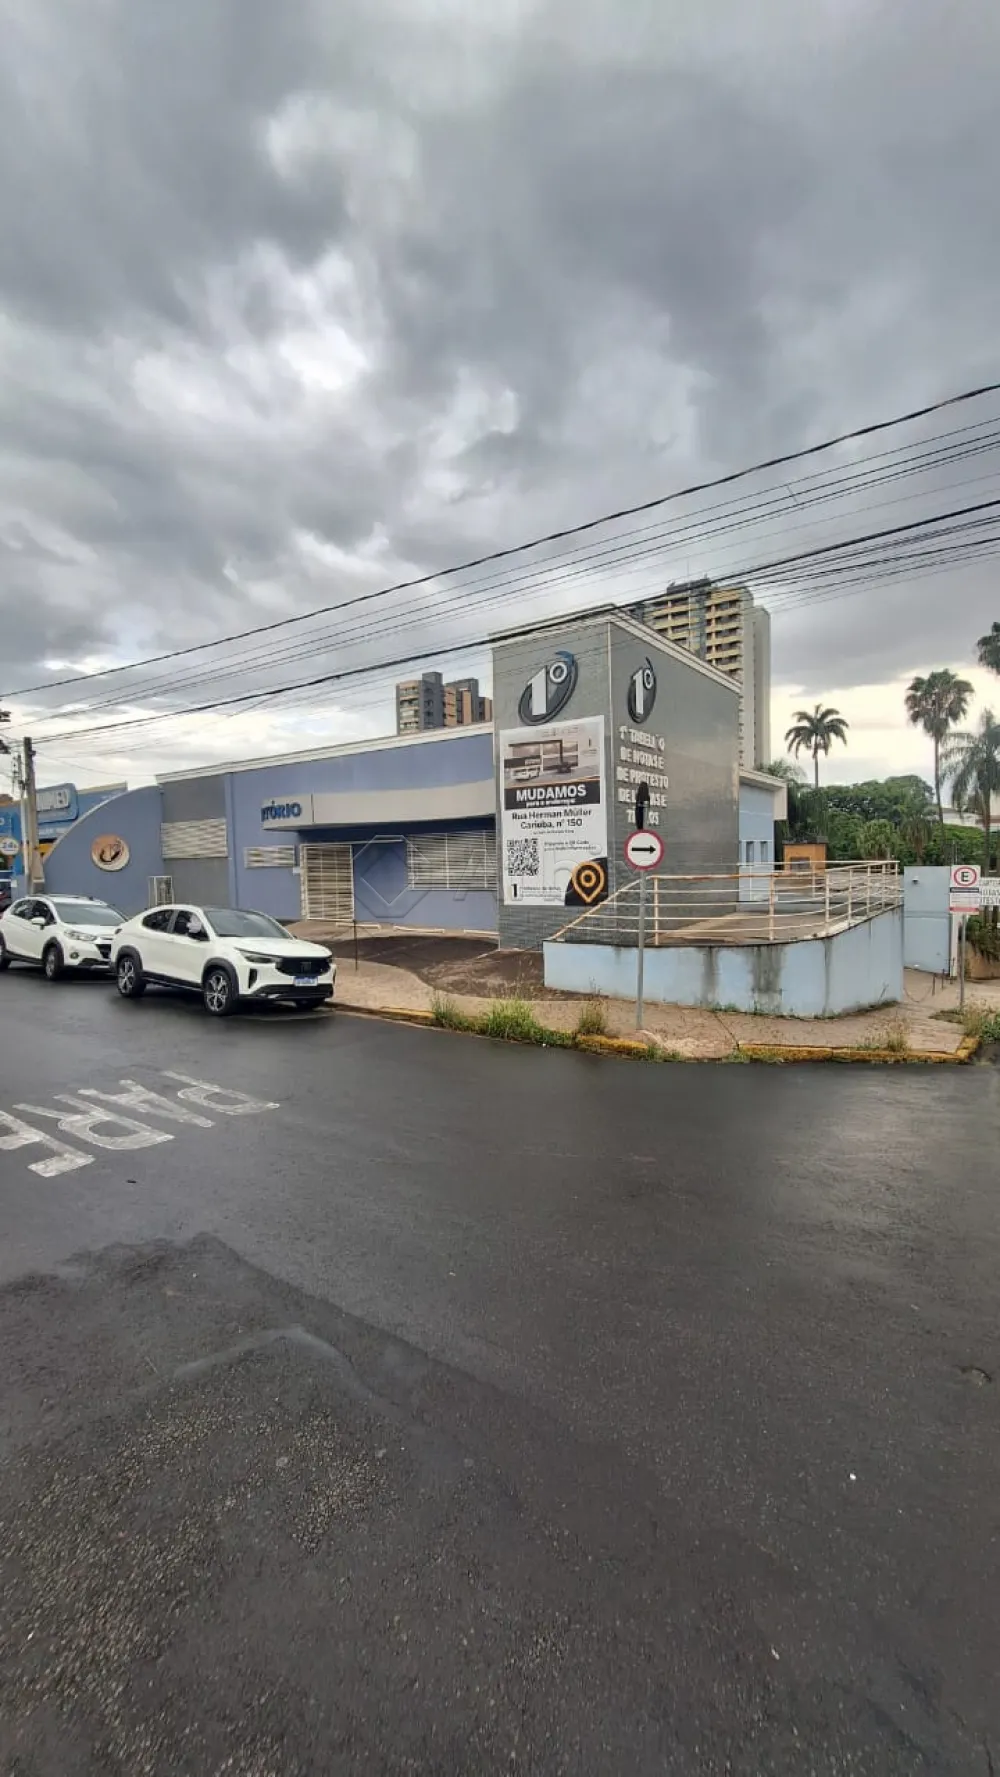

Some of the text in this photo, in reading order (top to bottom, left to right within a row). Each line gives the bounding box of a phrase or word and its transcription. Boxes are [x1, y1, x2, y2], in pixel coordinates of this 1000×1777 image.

[620, 746, 632, 762] DE
[616, 766, 669, 789] DE PROTESTO
[516, 784, 587, 802] MUDAMOS
[512, 812, 527, 820] Rua
[567, 818, 583, 827] 150
[960, 871, 970, 882] E
